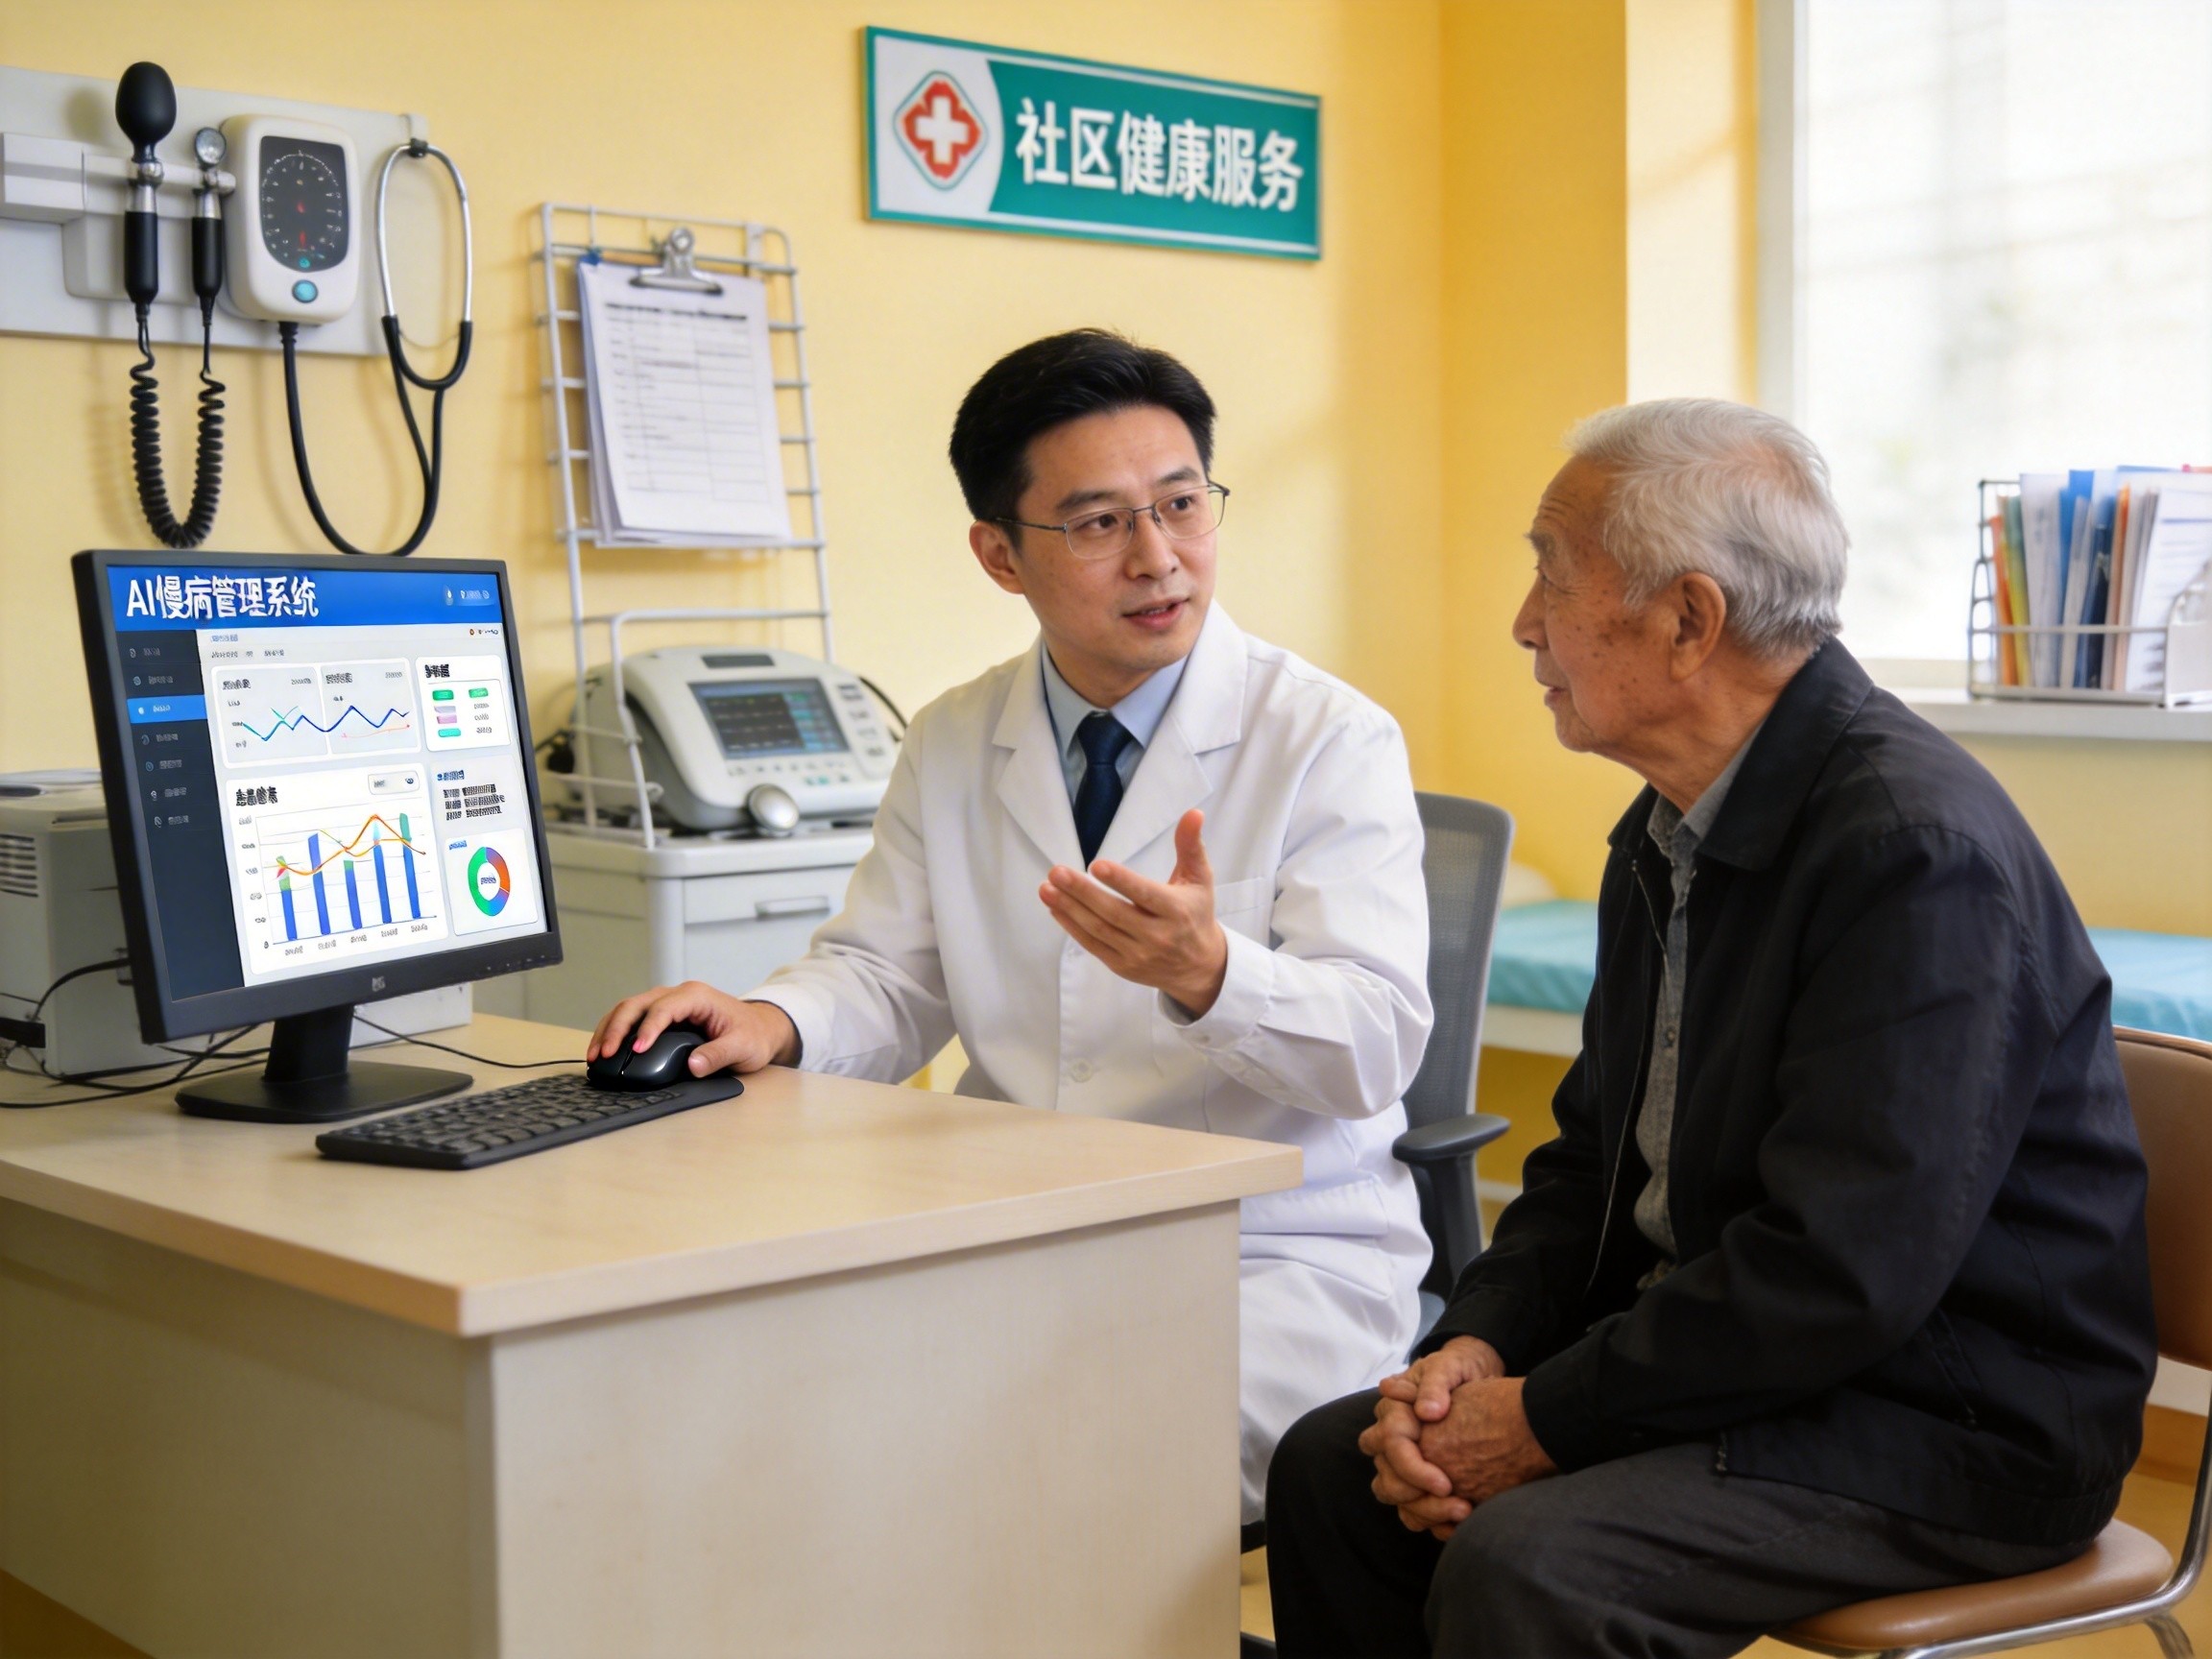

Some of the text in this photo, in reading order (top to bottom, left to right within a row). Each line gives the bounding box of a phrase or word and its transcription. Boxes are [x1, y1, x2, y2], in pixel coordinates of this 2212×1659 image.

[1016, 98, 1304, 212] 社区健康服务
[126, 574, 320, 619] AI慢病管理系统
